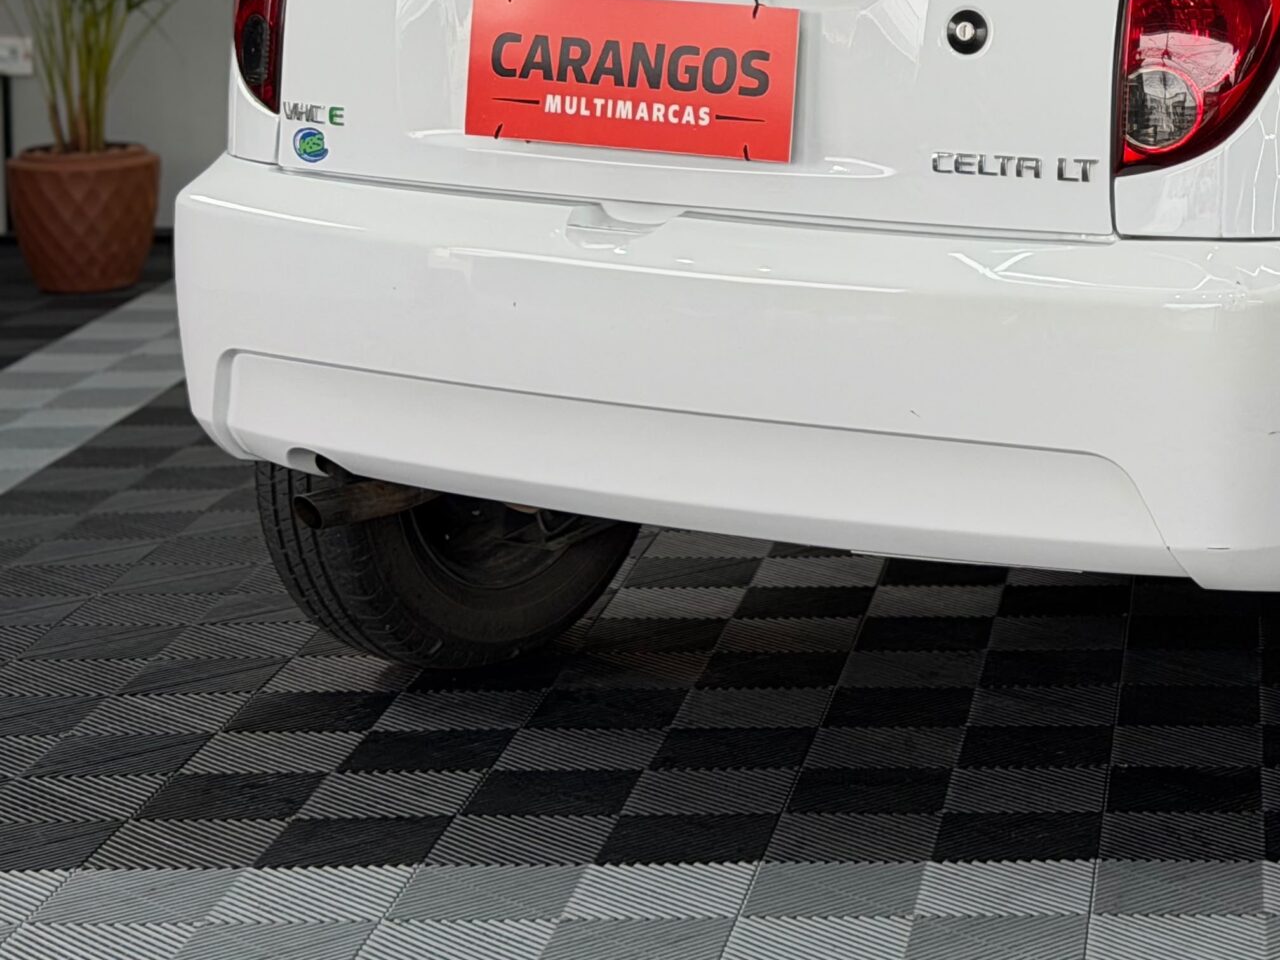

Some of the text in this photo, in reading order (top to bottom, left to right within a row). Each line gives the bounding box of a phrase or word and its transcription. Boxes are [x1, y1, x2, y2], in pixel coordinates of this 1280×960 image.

[490, 31, 771, 98] CARANGOS
[543, 93, 711, 126] MULTIMARCAS
[931, 151, 1099, 182] CELTA LT
